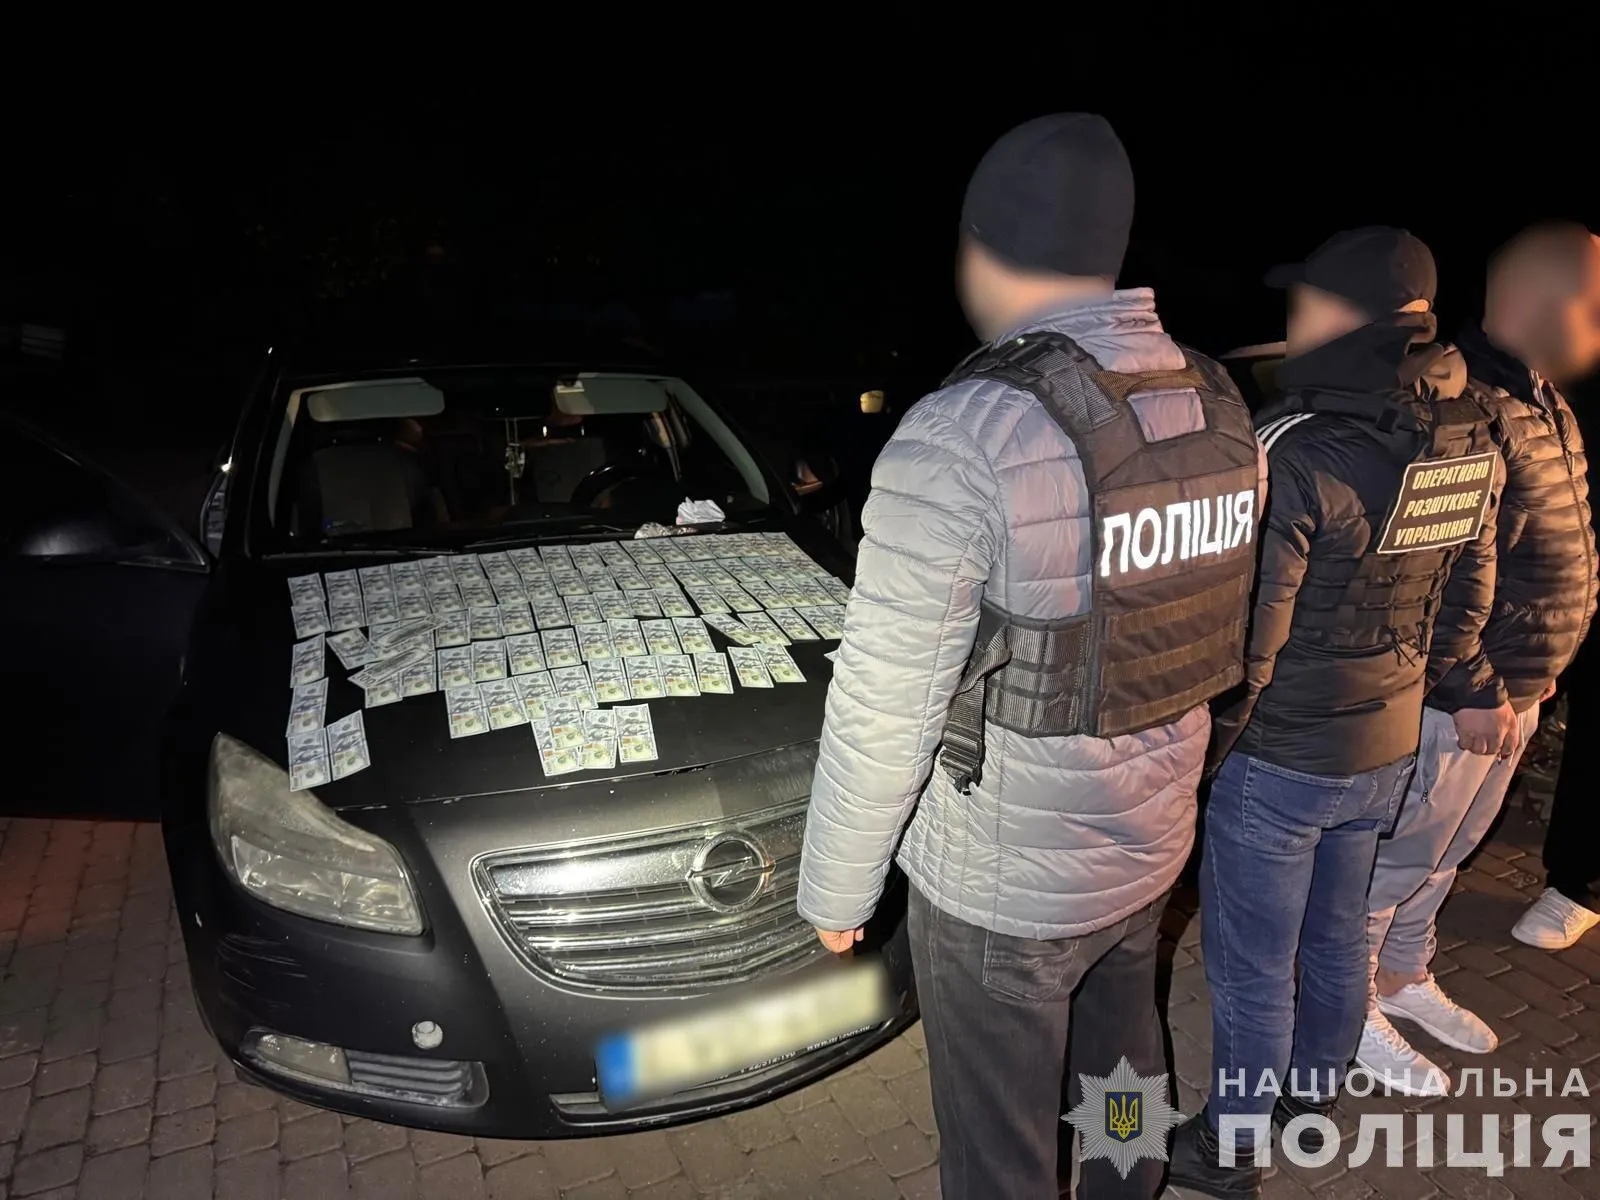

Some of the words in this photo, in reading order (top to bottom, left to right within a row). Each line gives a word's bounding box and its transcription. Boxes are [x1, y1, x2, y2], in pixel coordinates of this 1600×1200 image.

[1412, 461, 1490, 490] ОПЕРАТИВНО
[1403, 490, 1482, 519] РОЗШУКОВЕ
[1100, 490, 1255, 577] ПОЛІЦІЯ
[1393, 517, 1474, 547] УПРАВЛІННЯ
